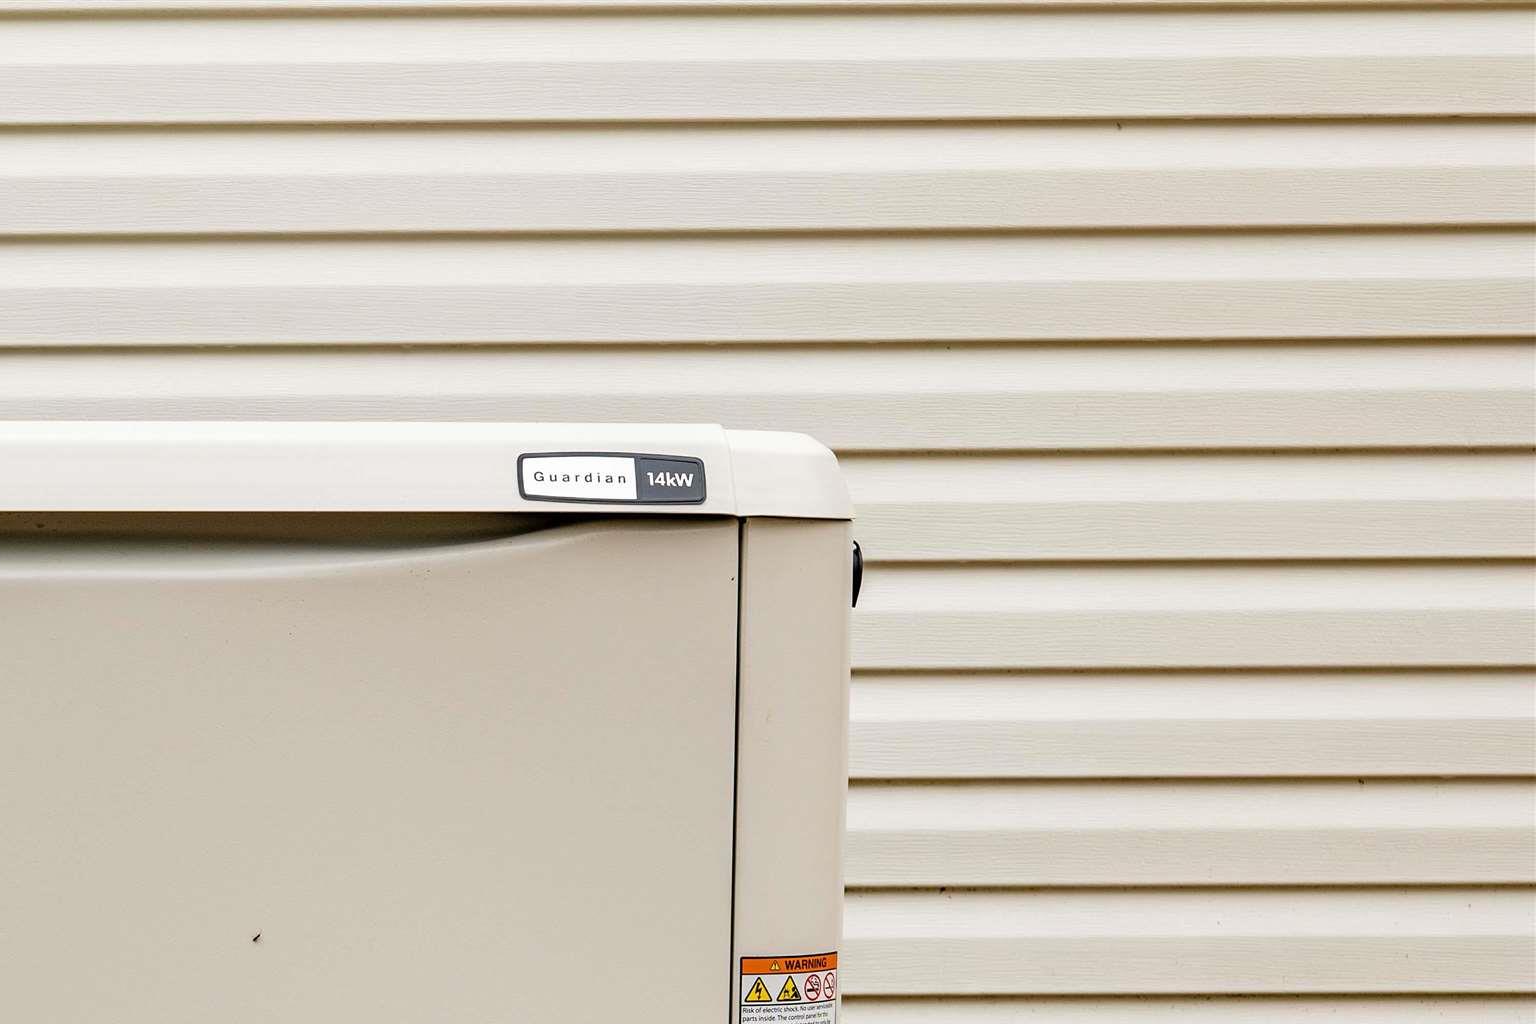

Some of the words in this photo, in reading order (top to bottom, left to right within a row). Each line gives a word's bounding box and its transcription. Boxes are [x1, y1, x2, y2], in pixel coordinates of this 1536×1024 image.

[534, 471, 627, 483] Guardian
[647, 472, 693, 487] 14kW
[785, 958, 827, 970] WARNING
